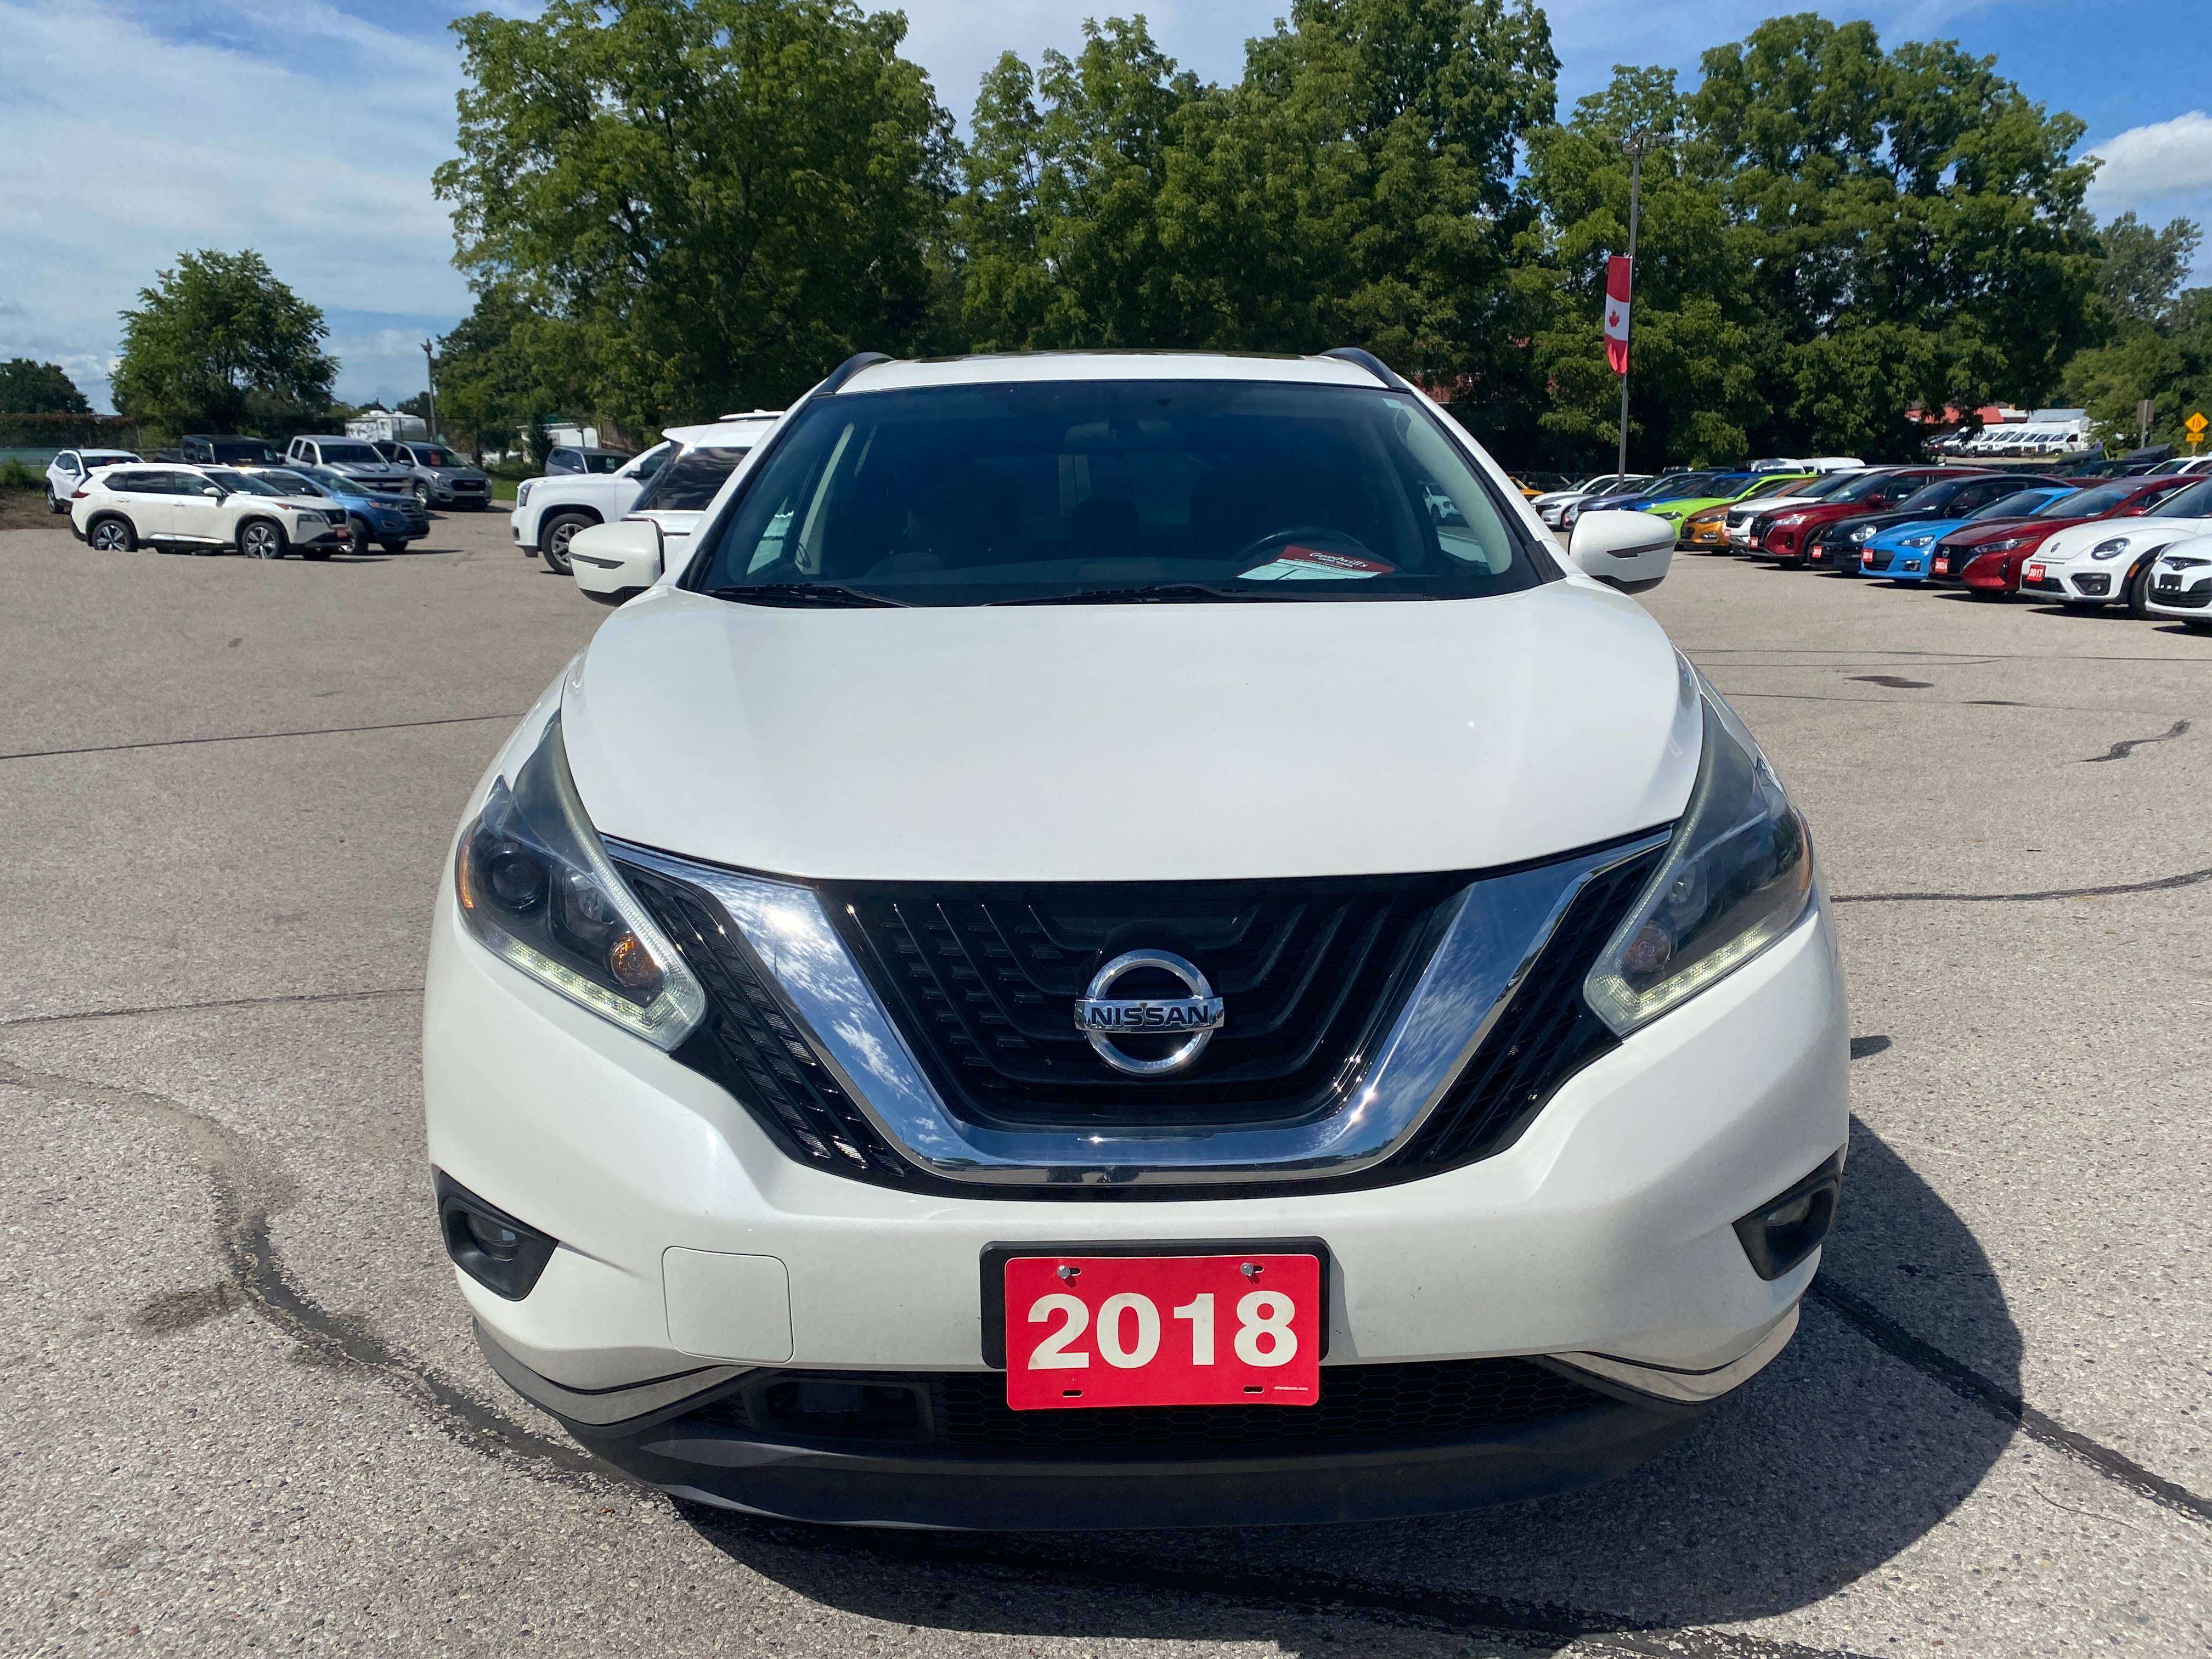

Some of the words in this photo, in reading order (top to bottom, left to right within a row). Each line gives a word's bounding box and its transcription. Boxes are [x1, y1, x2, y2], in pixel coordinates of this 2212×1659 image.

[2028, 568, 2044, 578] 2017
[1091, 1005, 1209, 1026] NISSAN
[1028, 1290, 1298, 1370] 2018
